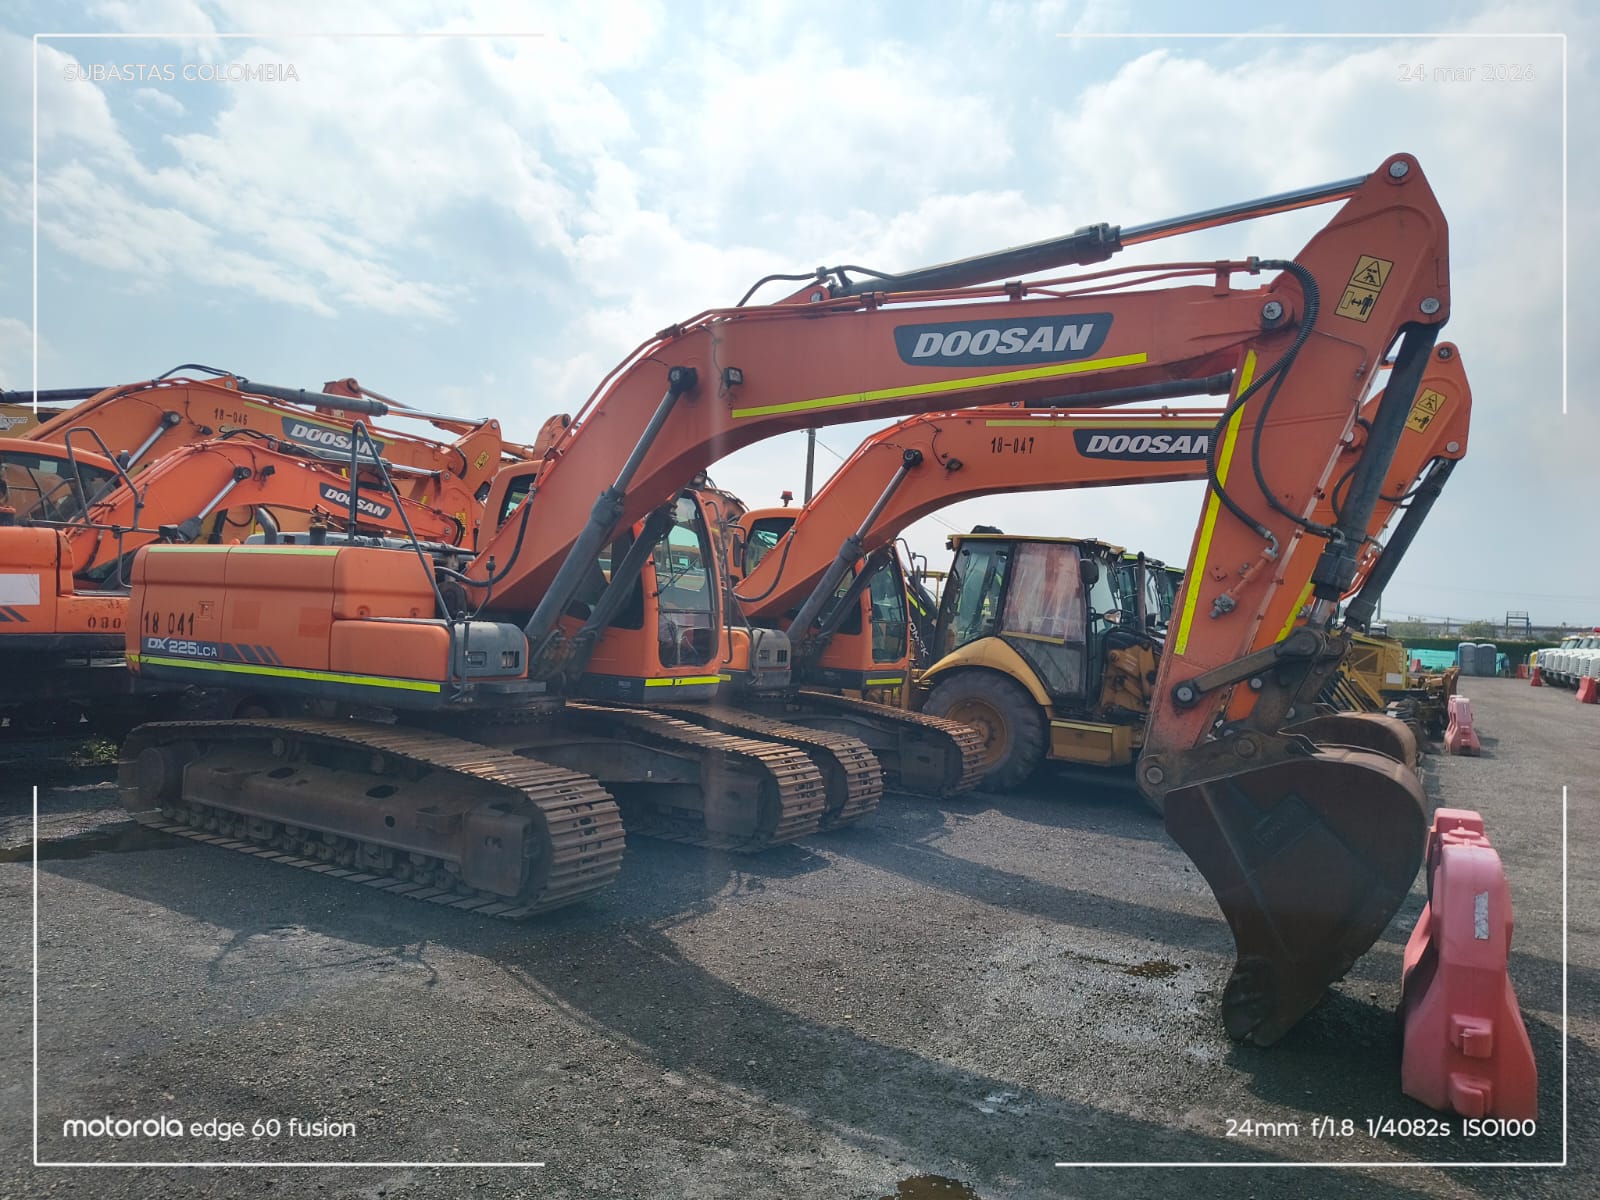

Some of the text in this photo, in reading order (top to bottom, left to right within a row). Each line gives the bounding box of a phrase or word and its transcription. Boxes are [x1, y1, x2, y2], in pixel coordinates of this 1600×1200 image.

[911, 323, 1094, 358] DOOSAN
[991, 436, 1034, 455] 18-047
[144, 611, 194, 637] 18 041
[147, 637, 218, 657] DX 225LCA
